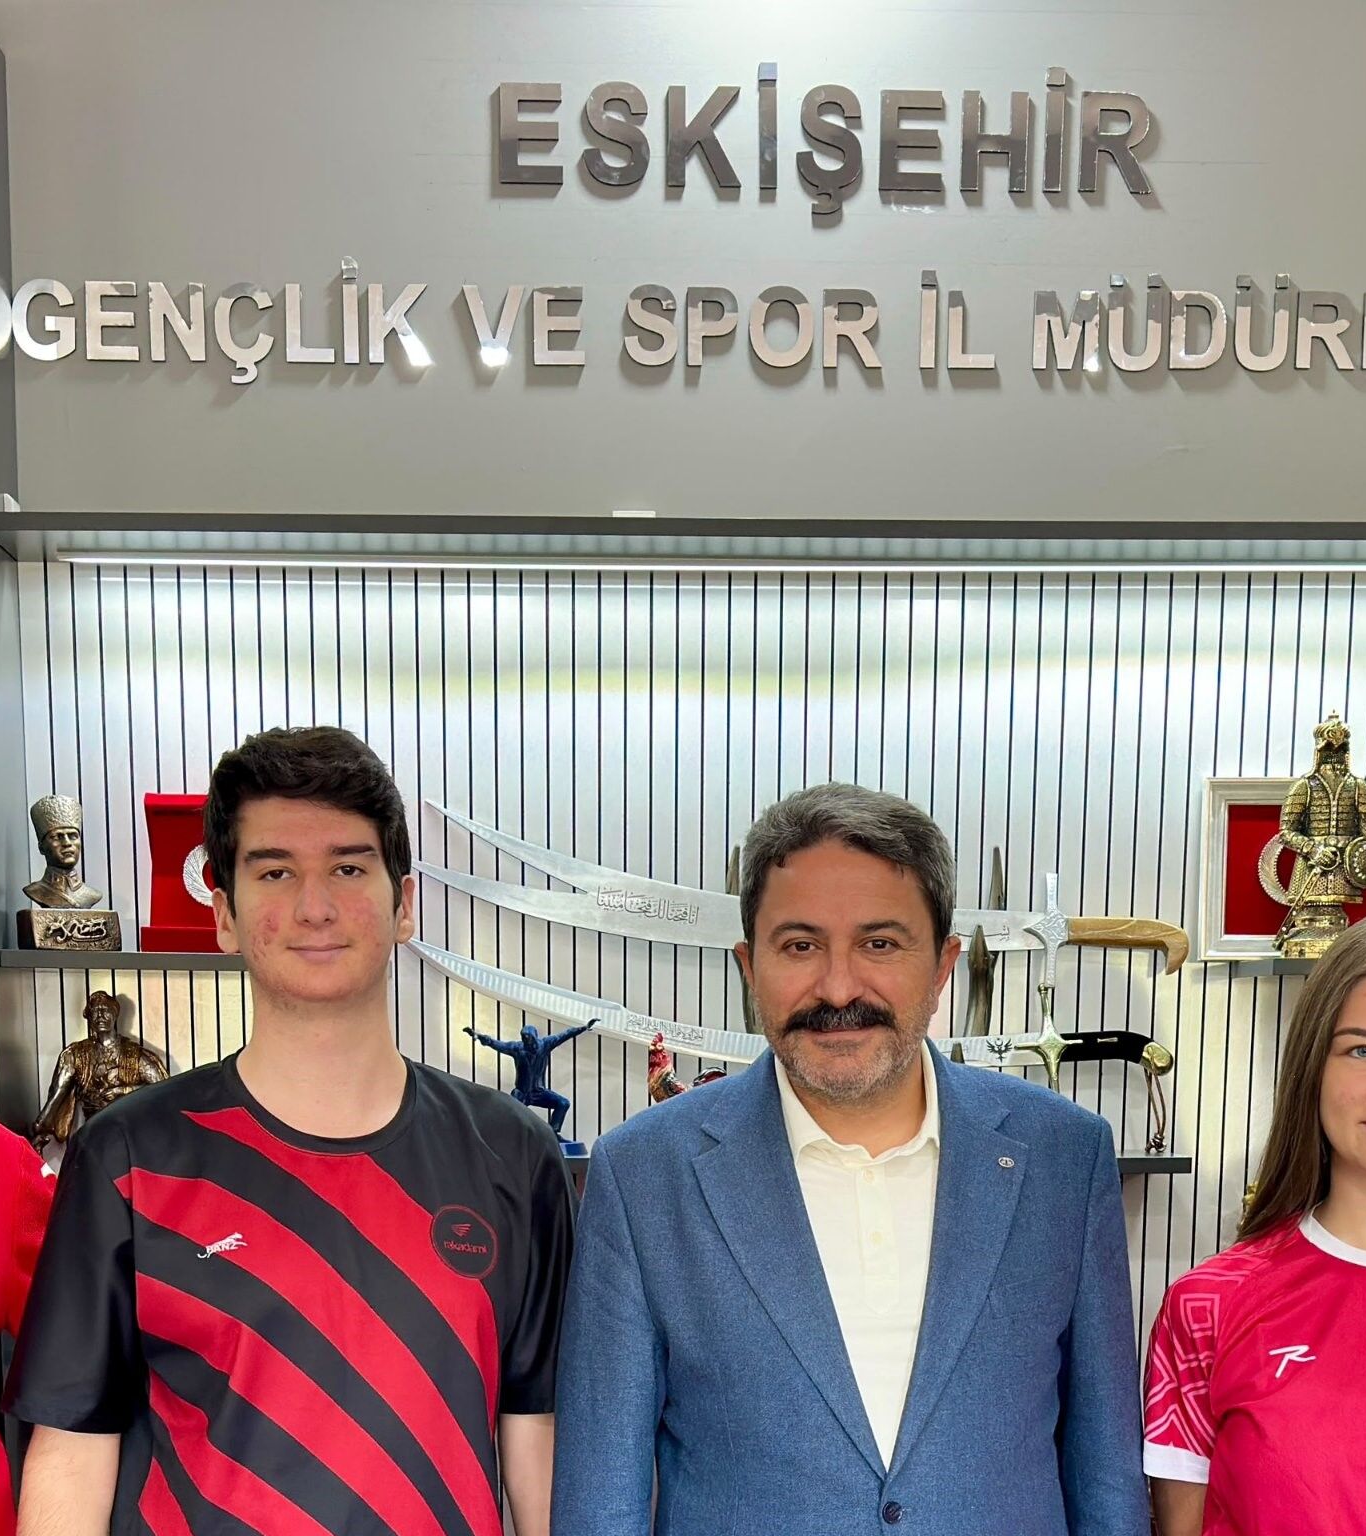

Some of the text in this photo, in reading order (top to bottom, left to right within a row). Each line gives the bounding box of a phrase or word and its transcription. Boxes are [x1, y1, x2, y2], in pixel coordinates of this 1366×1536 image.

[496, 62, 1155, 217] ESKİŞEHİR
[11, 255, 434, 384] GENÇLİK
[462, 283, 586, 368] VE
[623, 282, 883, 370] SPOR
[919, 268, 997, 370] İL
